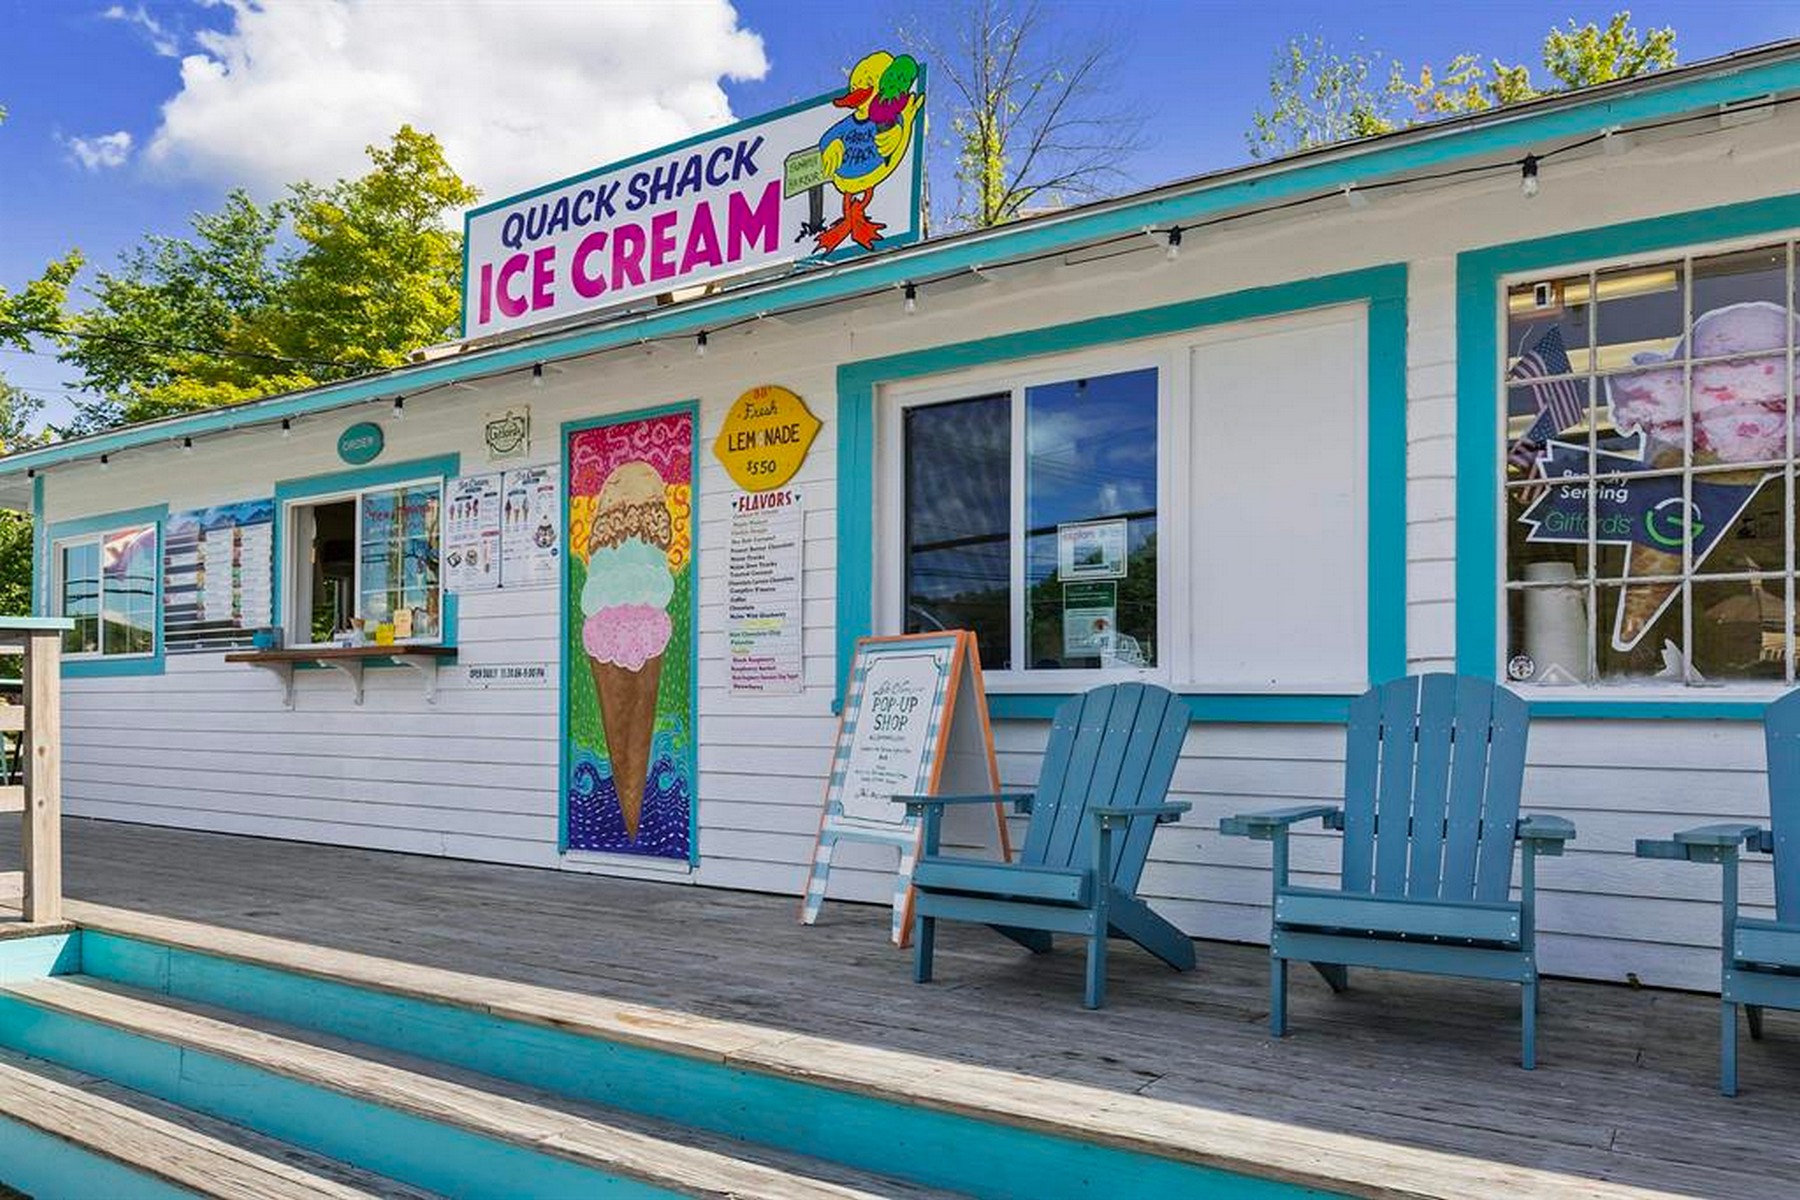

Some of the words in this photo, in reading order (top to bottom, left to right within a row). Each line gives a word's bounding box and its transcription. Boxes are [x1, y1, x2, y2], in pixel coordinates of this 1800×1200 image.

[502, 181, 621, 249] QUACK
[626, 136, 764, 211] SHACK
[478, 246, 556, 325] ICE
[571, 179, 780, 299] CREAM
[743, 400, 778, 420] Fresh
[739, 490, 792, 512] FLAVORS
[1560, 485, 1628, 503] Sering
[871, 696, 919, 713] POP-UP
[873, 713, 910, 732] SHOP
